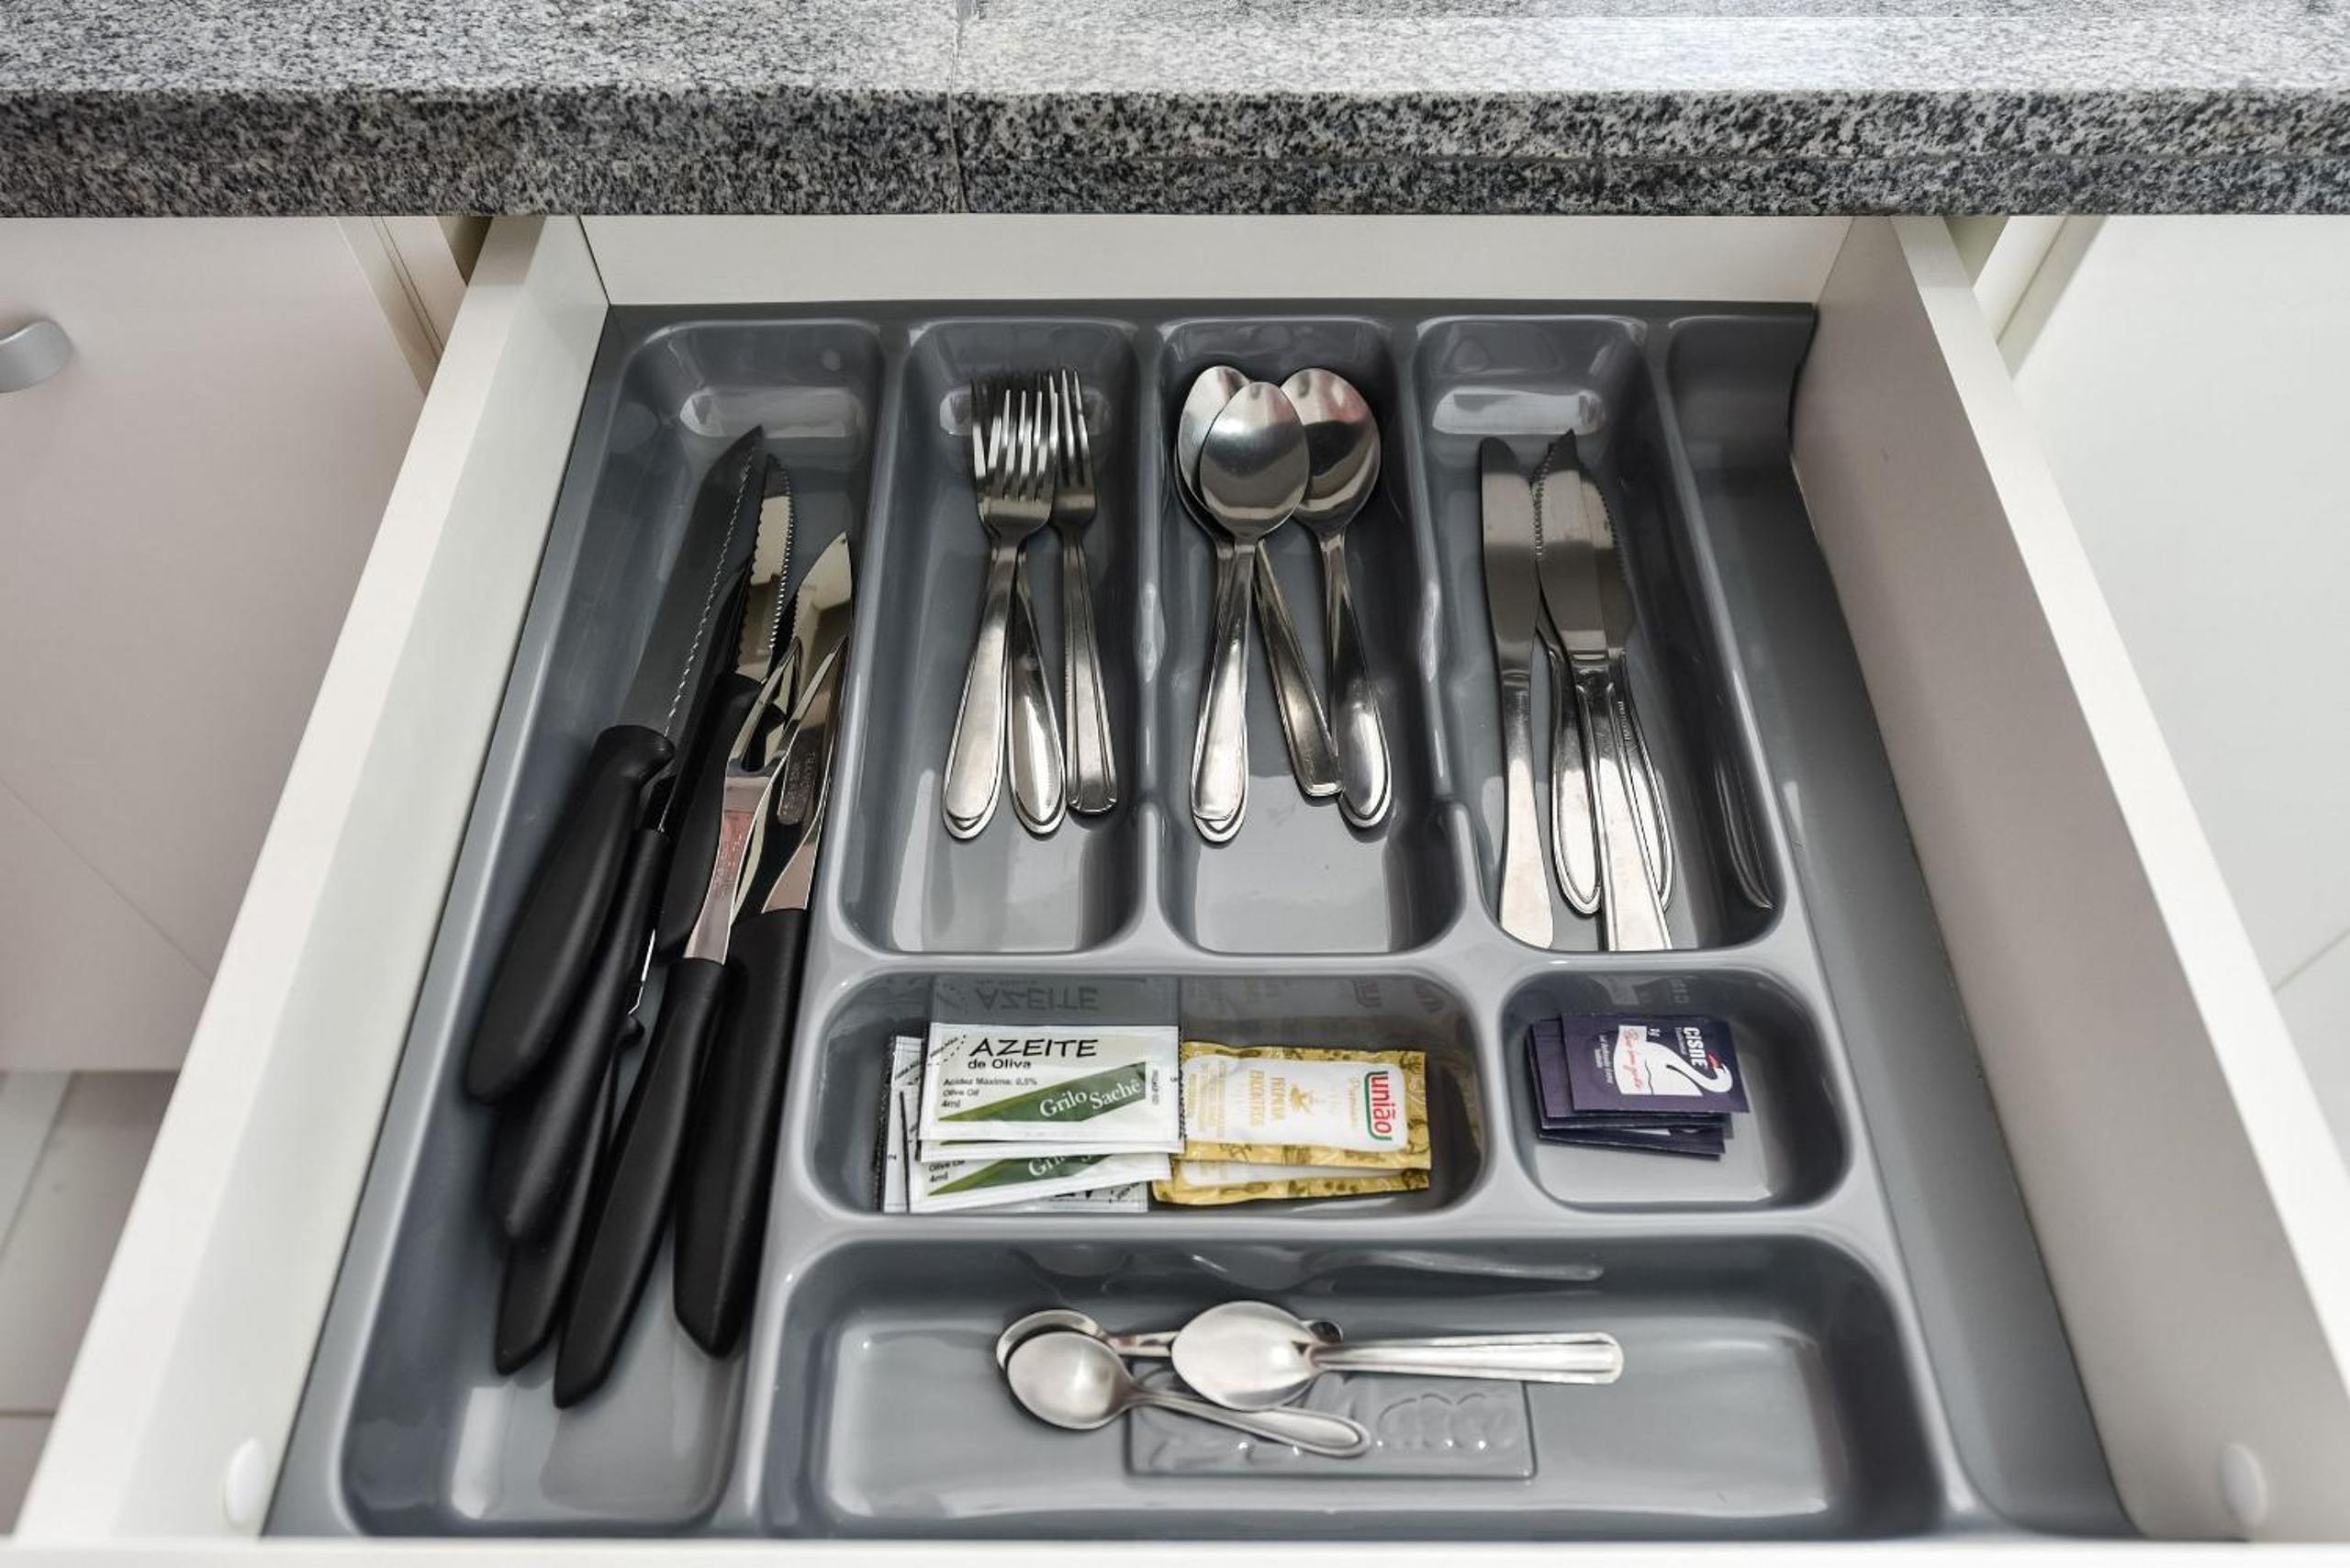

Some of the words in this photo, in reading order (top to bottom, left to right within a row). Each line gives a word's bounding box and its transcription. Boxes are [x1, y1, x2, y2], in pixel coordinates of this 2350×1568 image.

[968, 1038, 1100, 1058] AZEITE
[968, 1058, 987, 1070] de
[991, 1058, 1032, 1070] Oliva
[1039, 1090, 1088, 1117] Grilo
[1091, 1078, 1143, 1110] Sachê
[1371, 1075, 1396, 1135] união
